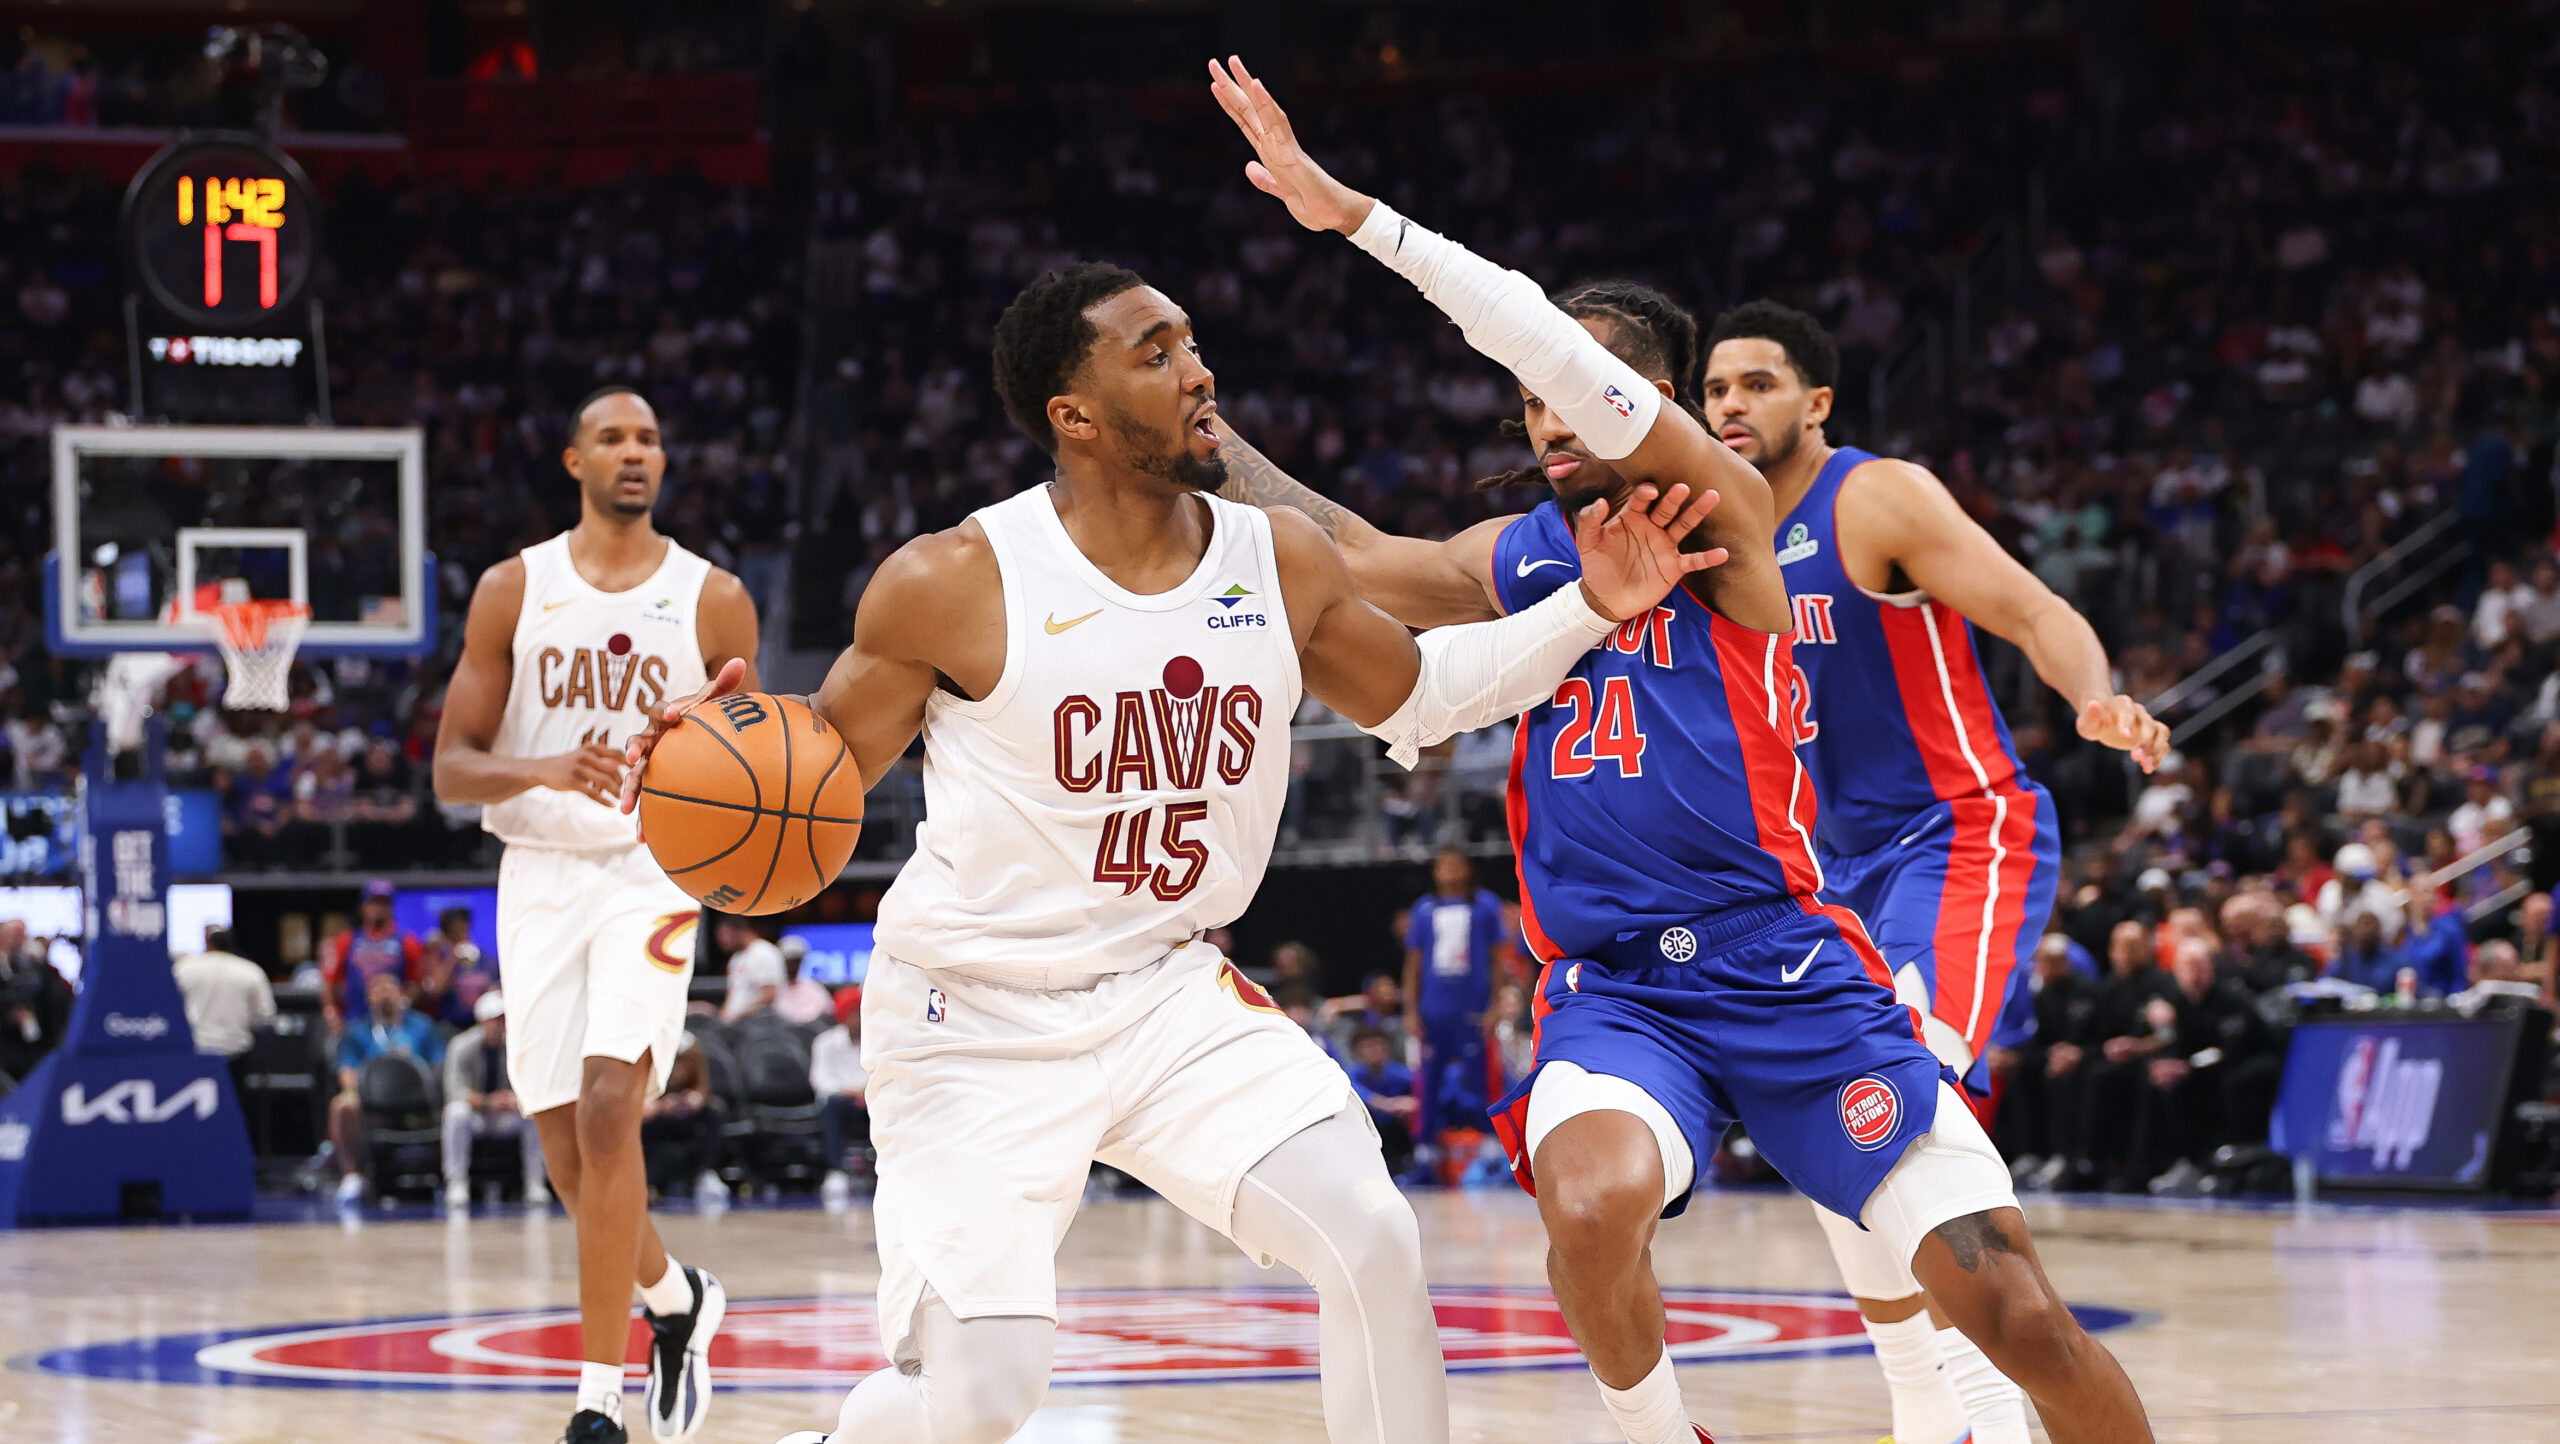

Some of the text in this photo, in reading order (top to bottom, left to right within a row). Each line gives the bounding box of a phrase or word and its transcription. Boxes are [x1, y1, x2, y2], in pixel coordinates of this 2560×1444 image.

[204, 223, 278, 309] 17
[1207, 614, 1266, 629] CLIFFS
[539, 647, 668, 716] CAVS
[1054, 685, 1262, 793] CAVS
[1551, 675, 1647, 780] 24
[1093, 800, 1209, 901] 45
[61, 1077, 218, 1126] KIA
[1846, 1090, 1883, 1121] DETROIT
[1851, 1100, 1890, 1132] PISTONS
